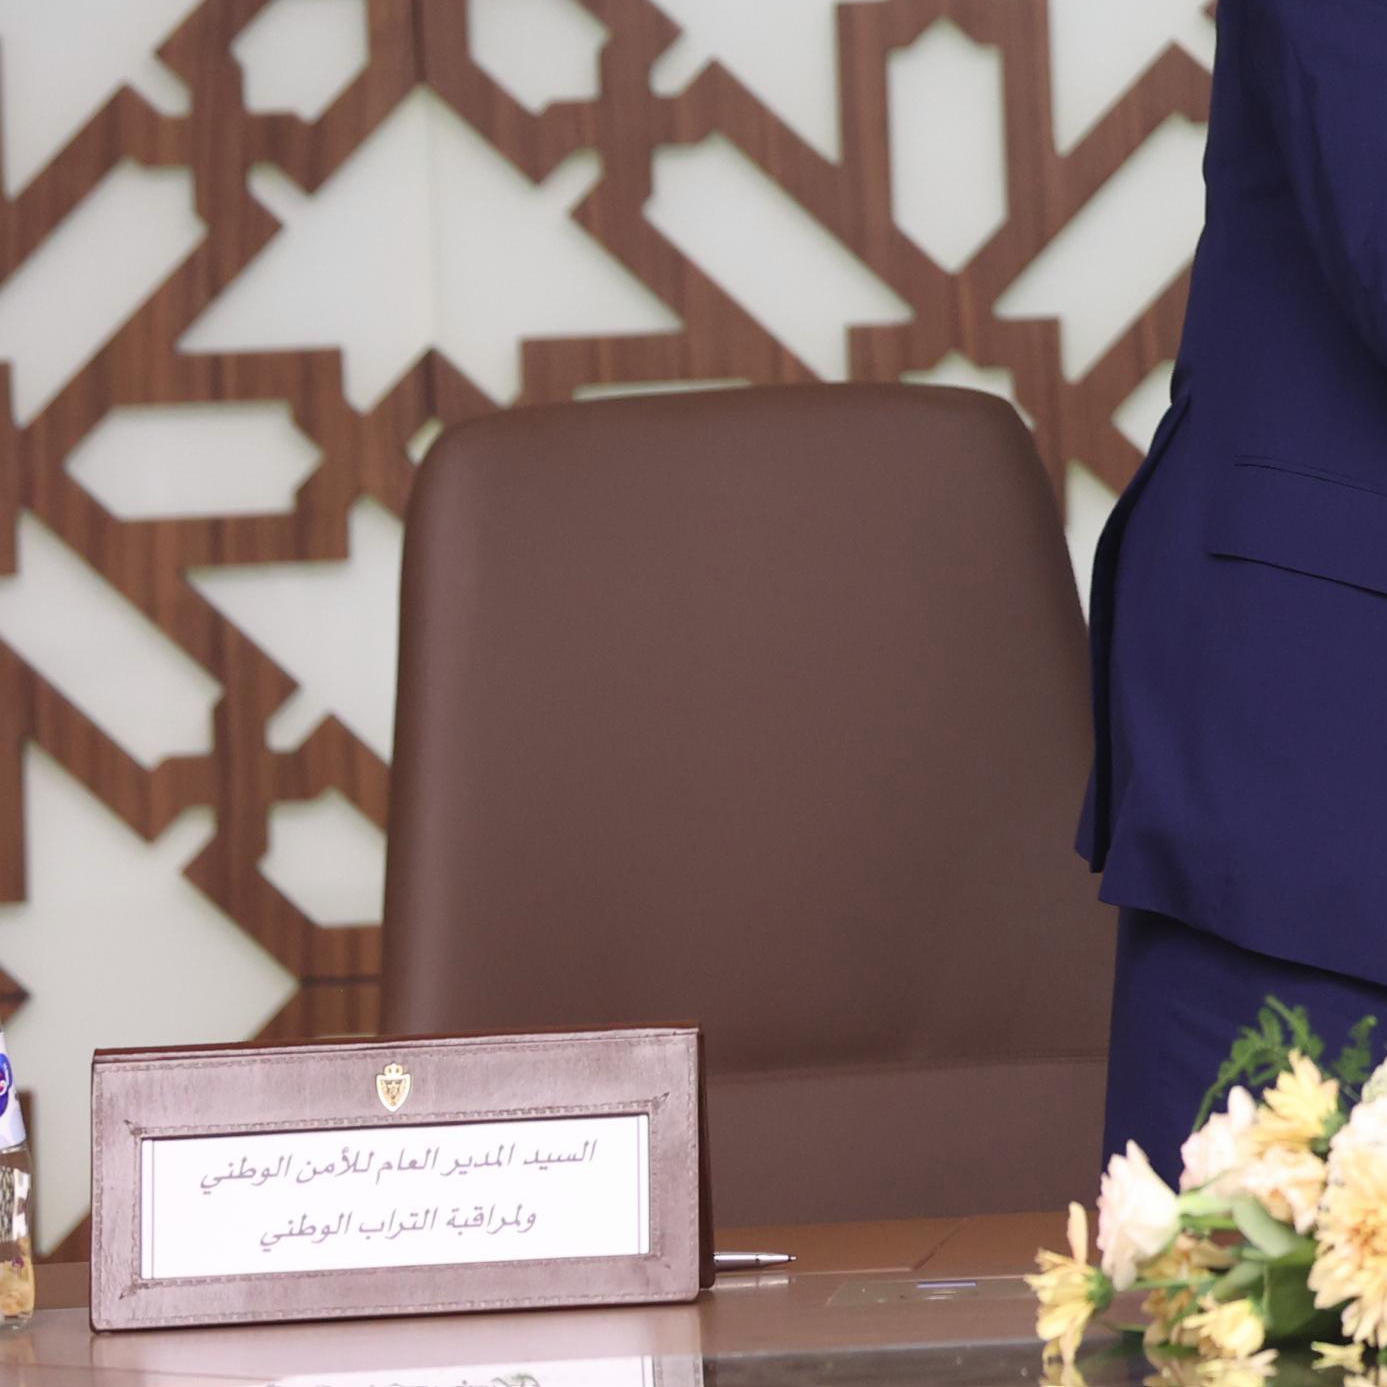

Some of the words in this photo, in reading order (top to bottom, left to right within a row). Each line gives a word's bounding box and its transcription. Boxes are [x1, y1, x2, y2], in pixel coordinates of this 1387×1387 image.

[295, 1146, 375, 1184] للأمن
[376, 1147, 440, 1184] العام
[442, 1144, 516, 1177] المدير
[523, 1140, 597, 1171] السيد
[199, 1155, 292, 1196] الوطني
[259, 1212, 353, 1253] الوطني
[358, 1208, 438, 1240] التراب
[446, 1203, 537, 1236] ولمراقبة
